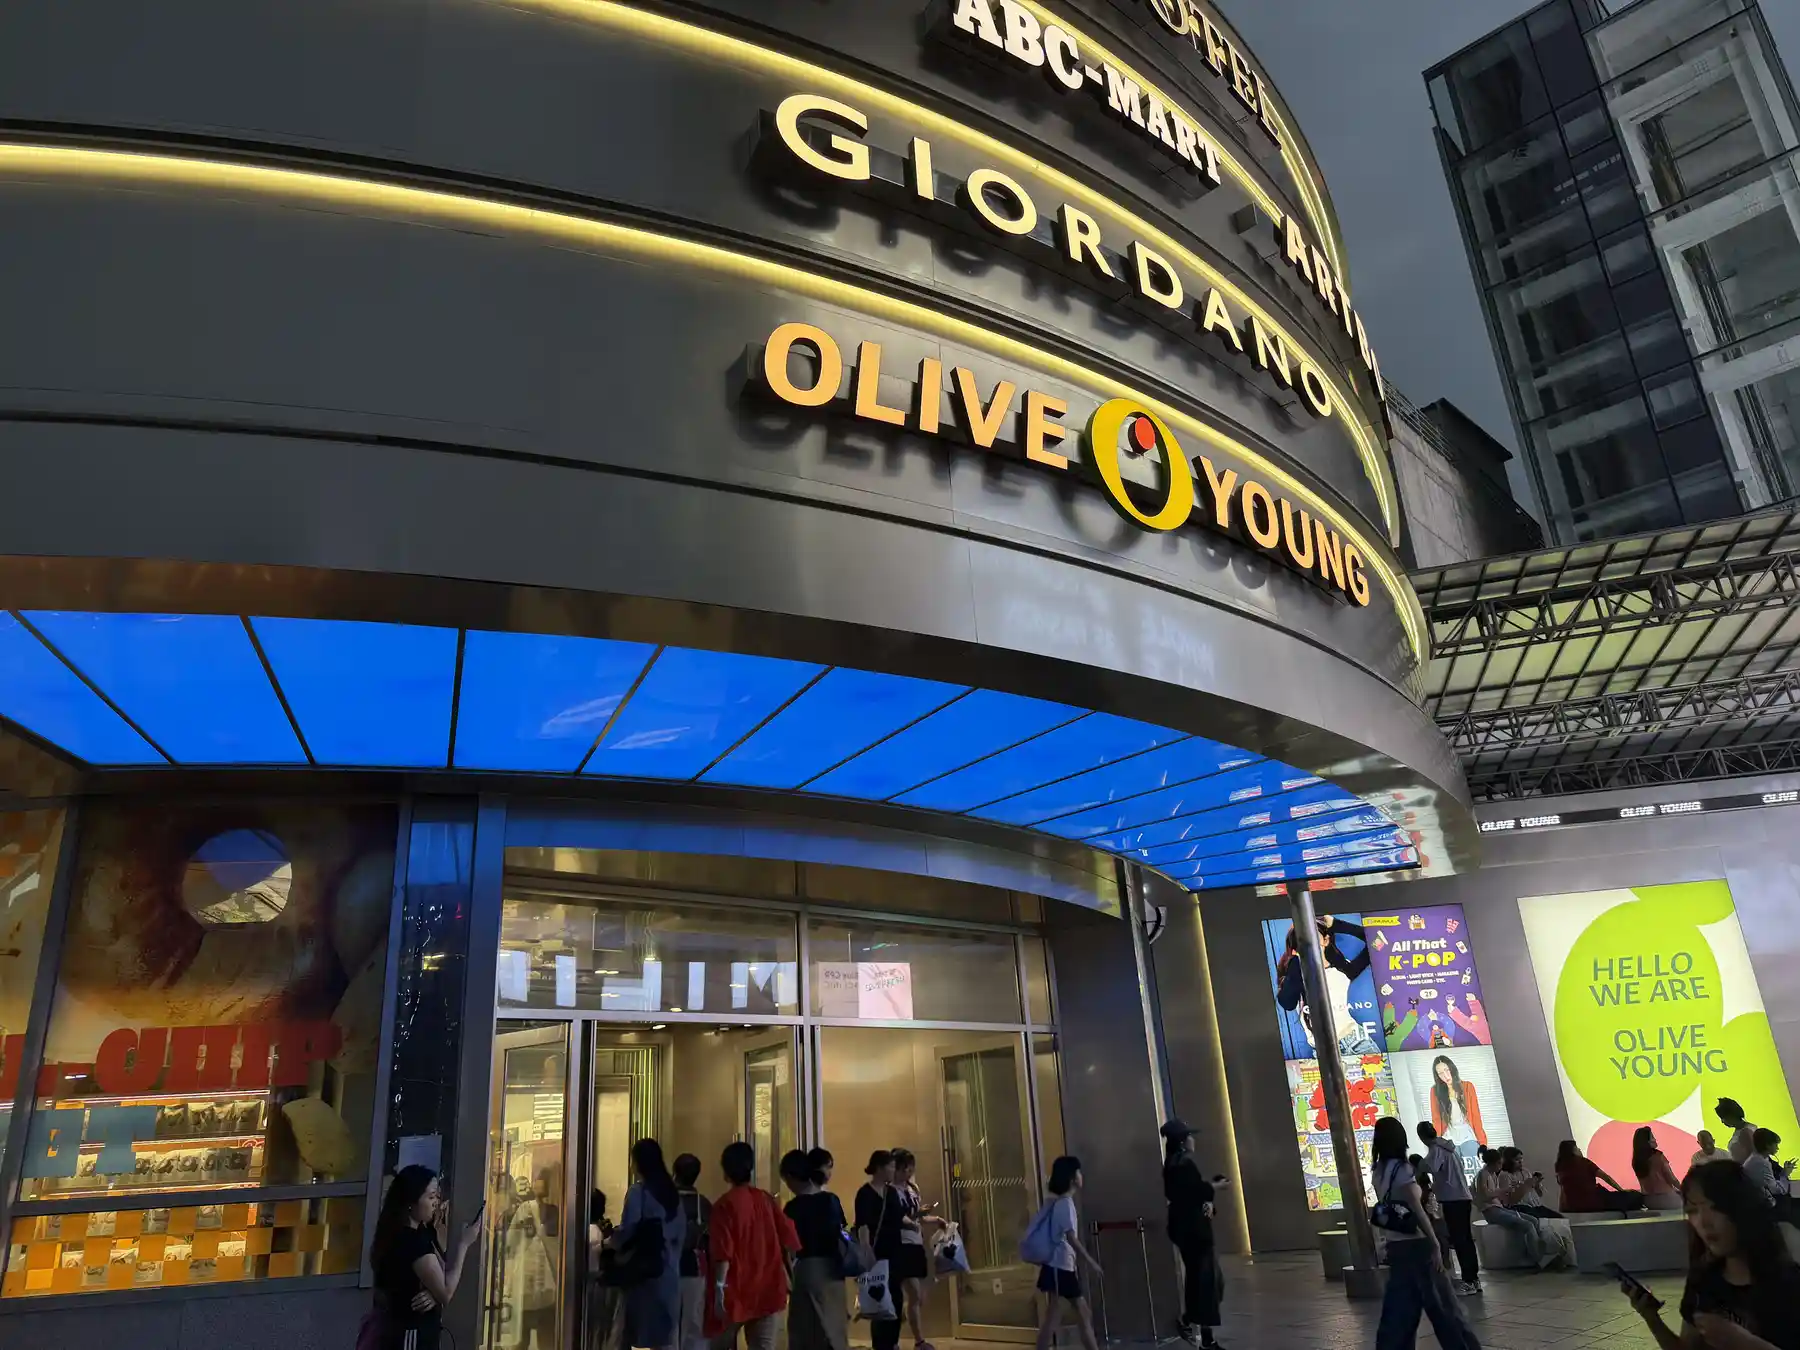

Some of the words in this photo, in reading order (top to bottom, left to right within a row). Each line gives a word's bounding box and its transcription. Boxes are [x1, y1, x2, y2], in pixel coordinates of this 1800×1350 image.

[953, 0, 1221, 185] ABC-MART
[776, 94, 1332, 416] GIORDANO
[765, 322, 1068, 470] OLIVE
[1199, 455, 1370, 607] YOUNG
[1481, 819, 1515, 831] OLIVE
[1520, 815, 1560, 827] YOUNG
[1620, 806, 1655, 817] OLIVE
[1660, 801, 1701, 813] YOUNG
[1391, 940, 1411, 953] All
[1412, 938, 1447, 951] That
[1389, 951, 1456, 970] K-POP
[1593, 952, 1693, 981] HELLO
[1589, 982, 1641, 1007] WE
[1649, 976, 1710, 1003] ARE
[1613, 1024, 1707, 1053] OLIVE
[1609, 1049, 1729, 1080] YOUNG
